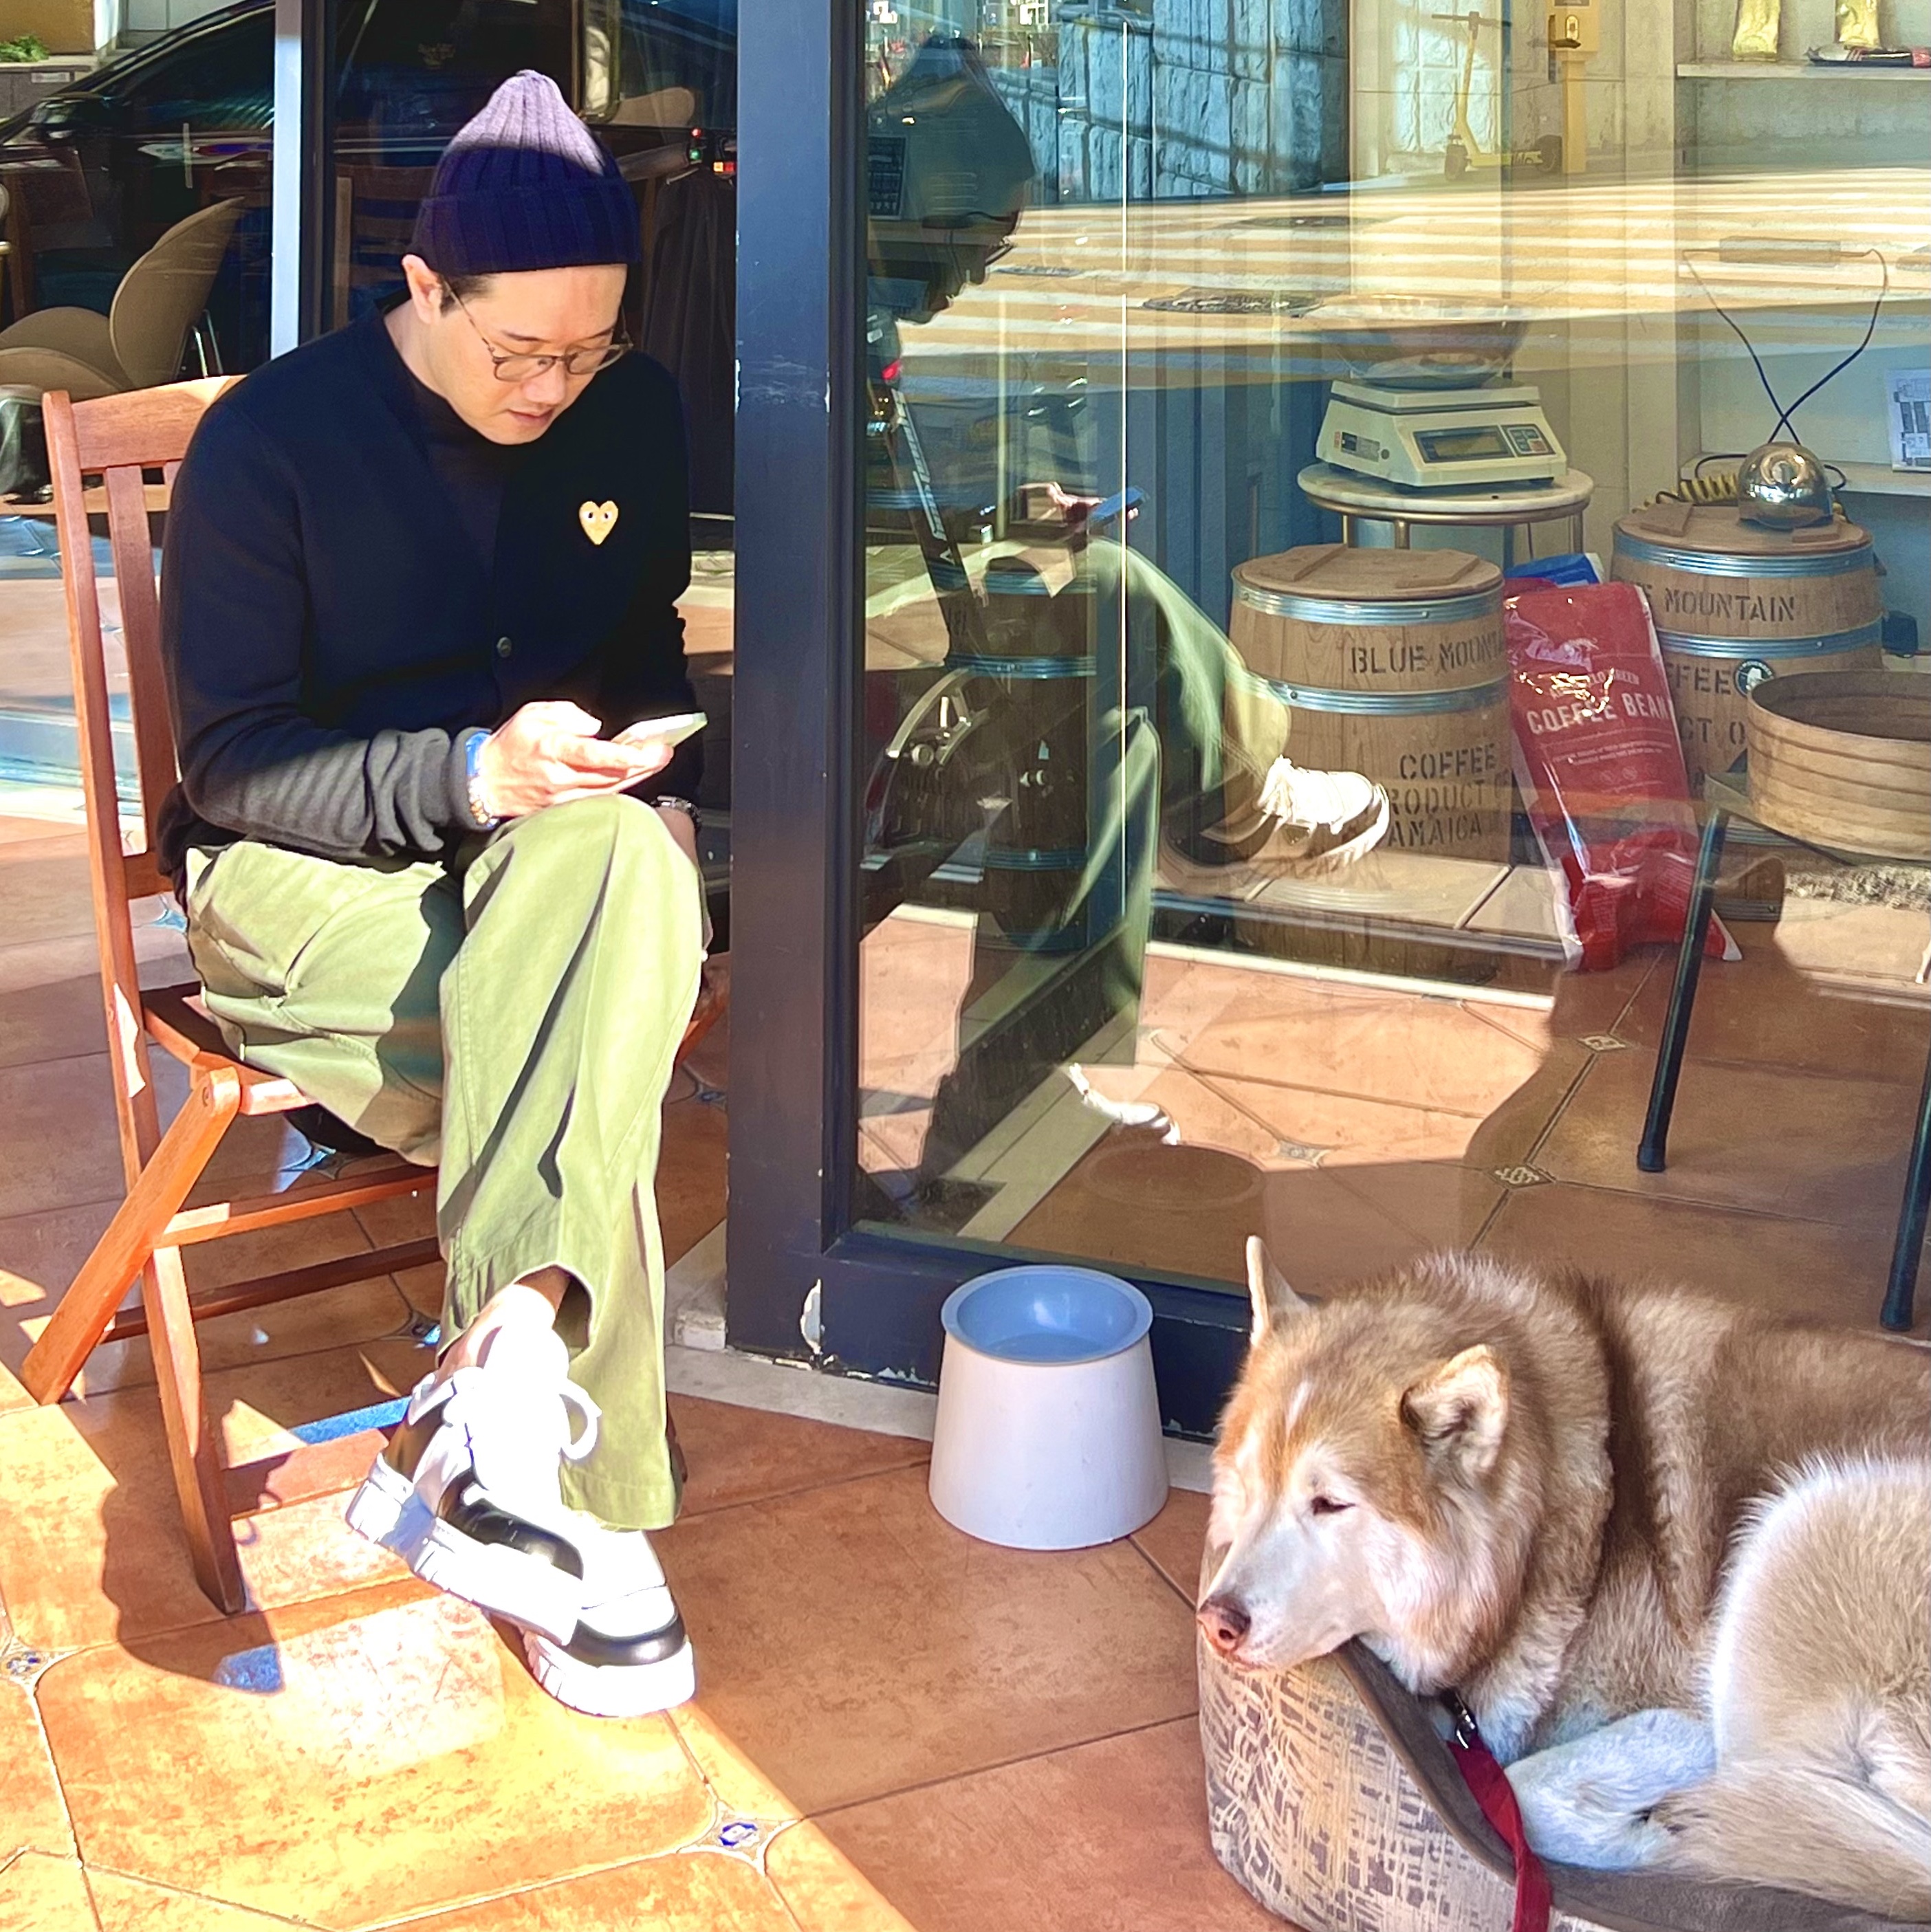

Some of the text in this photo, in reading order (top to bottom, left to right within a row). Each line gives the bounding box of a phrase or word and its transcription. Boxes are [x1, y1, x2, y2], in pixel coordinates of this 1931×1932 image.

[1665, 587, 1795, 622] MOUNTAIN
[1351, 630, 1505, 673] BLUE MOUNT
[1666, 662, 1731, 695] FEE
[1399, 743, 1496, 779] COFFEE
[1386, 779, 1485, 815] RODUCT
[1388, 811, 1483, 847] AMAICA
